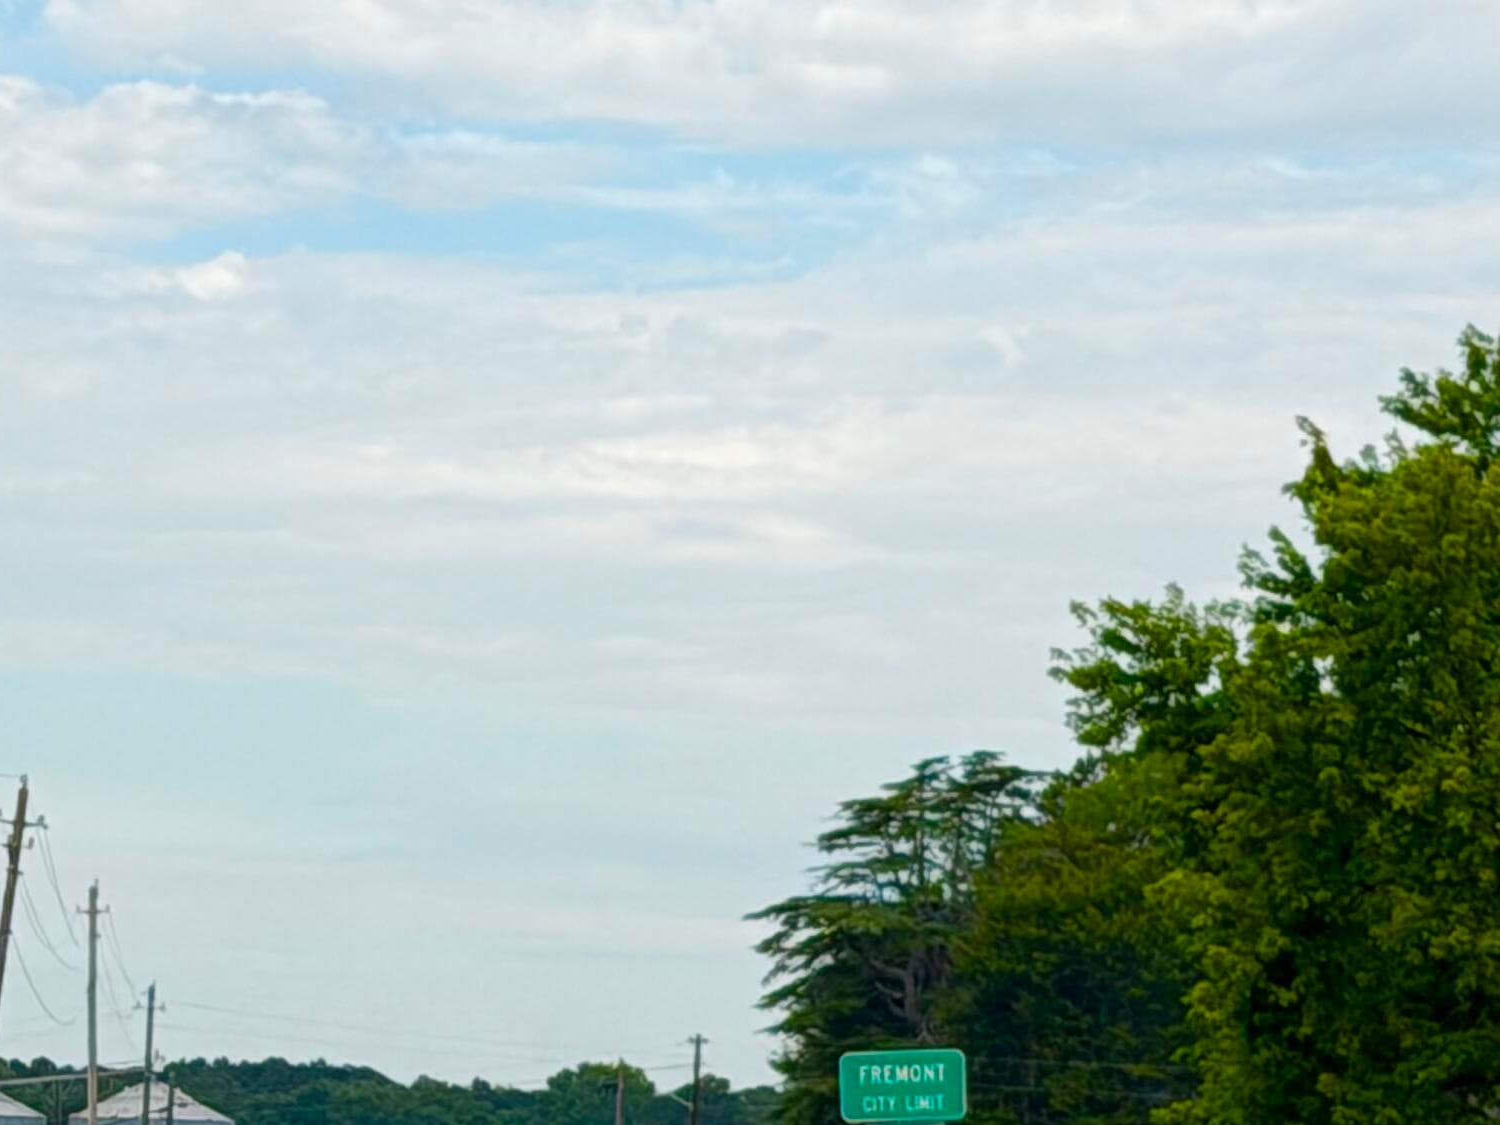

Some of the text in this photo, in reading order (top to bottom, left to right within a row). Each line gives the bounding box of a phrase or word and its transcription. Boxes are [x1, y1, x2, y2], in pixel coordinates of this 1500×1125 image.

[859, 1064, 945, 1085] FREMONT
[862, 1094, 945, 1113] CITY LIMIT
